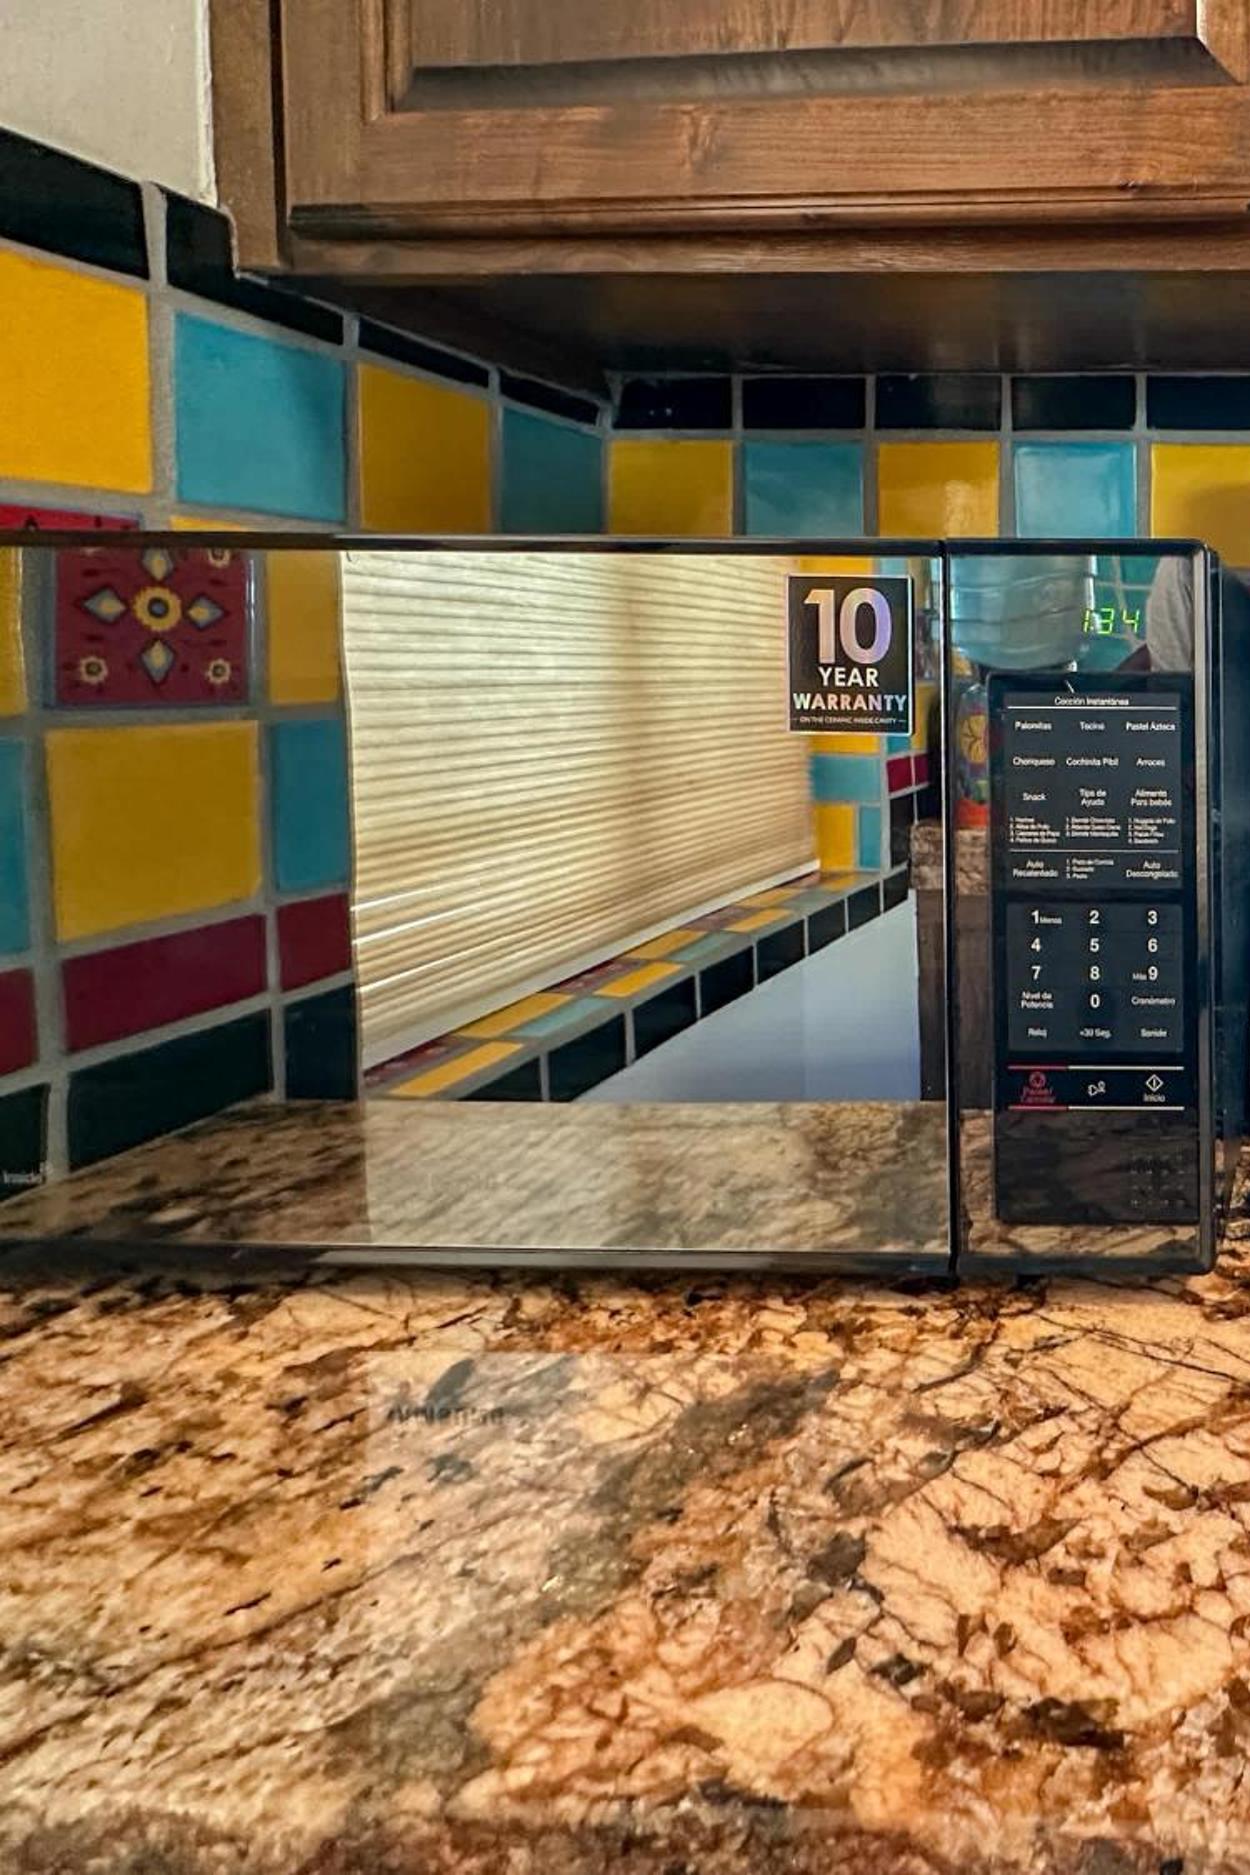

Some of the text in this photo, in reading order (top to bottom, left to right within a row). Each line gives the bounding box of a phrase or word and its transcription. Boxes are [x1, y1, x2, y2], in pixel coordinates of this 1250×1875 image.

[804, 588, 892, 664] 10
[818, 667, 879, 687] YEAR
[793, 693, 906, 711] WARRANTY
[1015, 722, 1052, 731] Palomitas
[1080, 722, 1105, 731] Tocino
[1126, 723, 1175, 731] Pastel Azteca
[1066, 757, 1119, 767] Cochinita Pibil
[1136, 758, 1165, 767] Arroces
[1023, 793, 1047, 801] Snack
[1097, 789, 1106, 797] de
[1081, 798, 1105, 807] Ayuda
[1131, 798, 1147, 806] Para
[1026, 860, 1044, 869] Auto
[1143, 861, 1160, 870] Auto
[1031, 911, 1039, 924] 1
[1089, 910, 1100, 924] 2
[1147, 910, 1157, 925] 3
[1031, 939, 1041, 952] 4
[1090, 939, 1099, 952] 5
[1147, 939, 1157, 953] 6
[1031, 966, 1042, 980] 7
[1090, 967, 1100, 980] 8
[1147, 967, 1157, 981] 9
[1040, 991, 1052, 999] de
[1021, 1000, 1054, 1009] Potencia
[1090, 995, 1100, 1008] 0
[1143, 1094, 1166, 1102] Inicio
